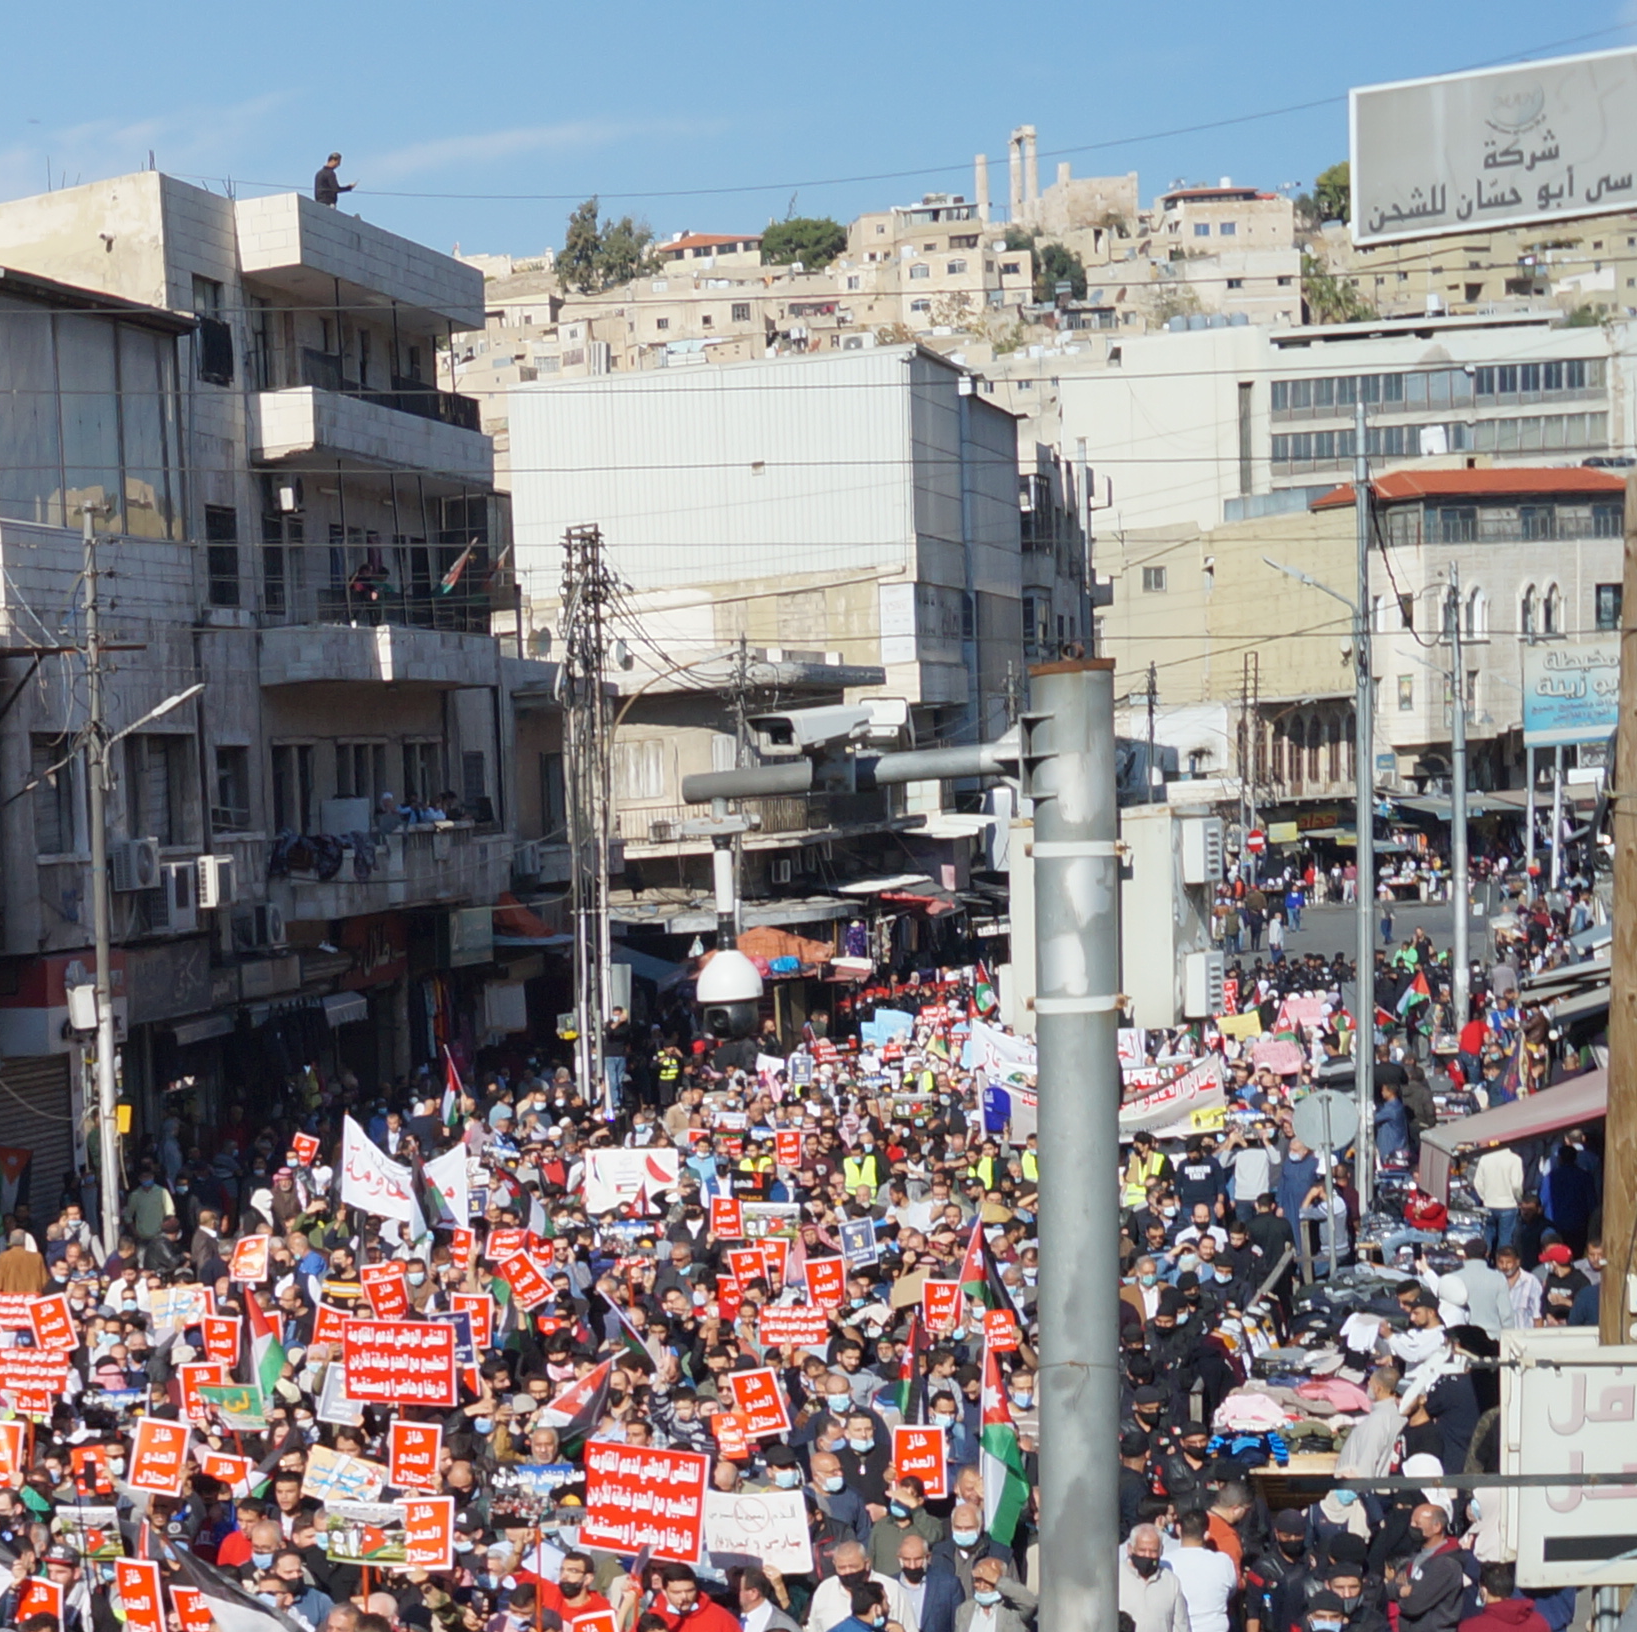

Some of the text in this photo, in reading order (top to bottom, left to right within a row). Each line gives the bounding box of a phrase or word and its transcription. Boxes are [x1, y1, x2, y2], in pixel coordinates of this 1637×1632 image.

[1483, 128, 1560, 171] شركة
[1537, 165, 1574, 210] أبو
[1369, 183, 1447, 233] للشحن
[1143, 1067, 1218, 1113] غاز العدو
[719, 1200, 732, 1212] غاز
[716, 1214, 737, 1225] العدو
[244, 1240, 257, 1249] غاز
[507, 1260, 522, 1273] غاز
[738, 1255, 755, 1268] غاز
[737, 1269, 760, 1281] العدو
[815, 1265, 834, 1279] غاز
[514, 1274, 536, 1291] العدو
[813, 1280, 839, 1294] العدو
[377, 1284, 394, 1298] غاز
[933, 1286, 952, 1299] غاز
[39, 1303, 55, 1318] غاز
[377, 1297, 403, 1309] العدو
[464, 1300, 479, 1312] غاز
[324, 1310, 339, 1323] غاز
[989, 1313, 1006, 1326] غاز
[39, 1318, 65, 1334] العدو
[212, 1320, 227, 1334] غاز
[987, 1326, 1013, 1336] العدو
[209, 1338, 232, 1350] العدو
[374, 1328, 422, 1350] الوطني لدعم
[370, 1352, 392, 1374] خيانة
[389, 1354, 409, 1371] العدو
[407, 1355, 421, 1372] مع
[420, 1355, 449, 1375] التطبيع
[194, 1370, 210, 1384] غاز
[743, 1378, 762, 1394] غاز
[744, 1398, 773, 1414] العدو
[746, 1412, 782, 1428] احتلال
[149, 1427, 173, 1443] غاز
[403, 1430, 424, 1444] غاز
[906, 1434, 928, 1449] غاز
[143, 1450, 177, 1464] العدو
[398, 1451, 430, 1465] العدو
[901, 1453, 936, 1470] العدو
[215, 1462, 236, 1476] غاز
[618, 1454, 641, 1477] لدعم
[640, 1458, 670, 1482] الوطني
[135, 1473, 176, 1487] احتلال
[395, 1468, 432, 1485] احتلال
[610, 1484, 634, 1509] خيانة
[632, 1489, 653, 1510] العدو
[651, 1491, 667, 1512] مع
[410, 1504, 434, 1521] غاز
[666, 1493, 698, 1517] التطبيع
[405, 1526, 442, 1541] العدو
[124, 1568, 143, 1586] غاز
[30, 1587, 48, 1602] غاز
[122, 1596, 150, 1610] العدو
[188, 1597, 208, 1612] غاز
